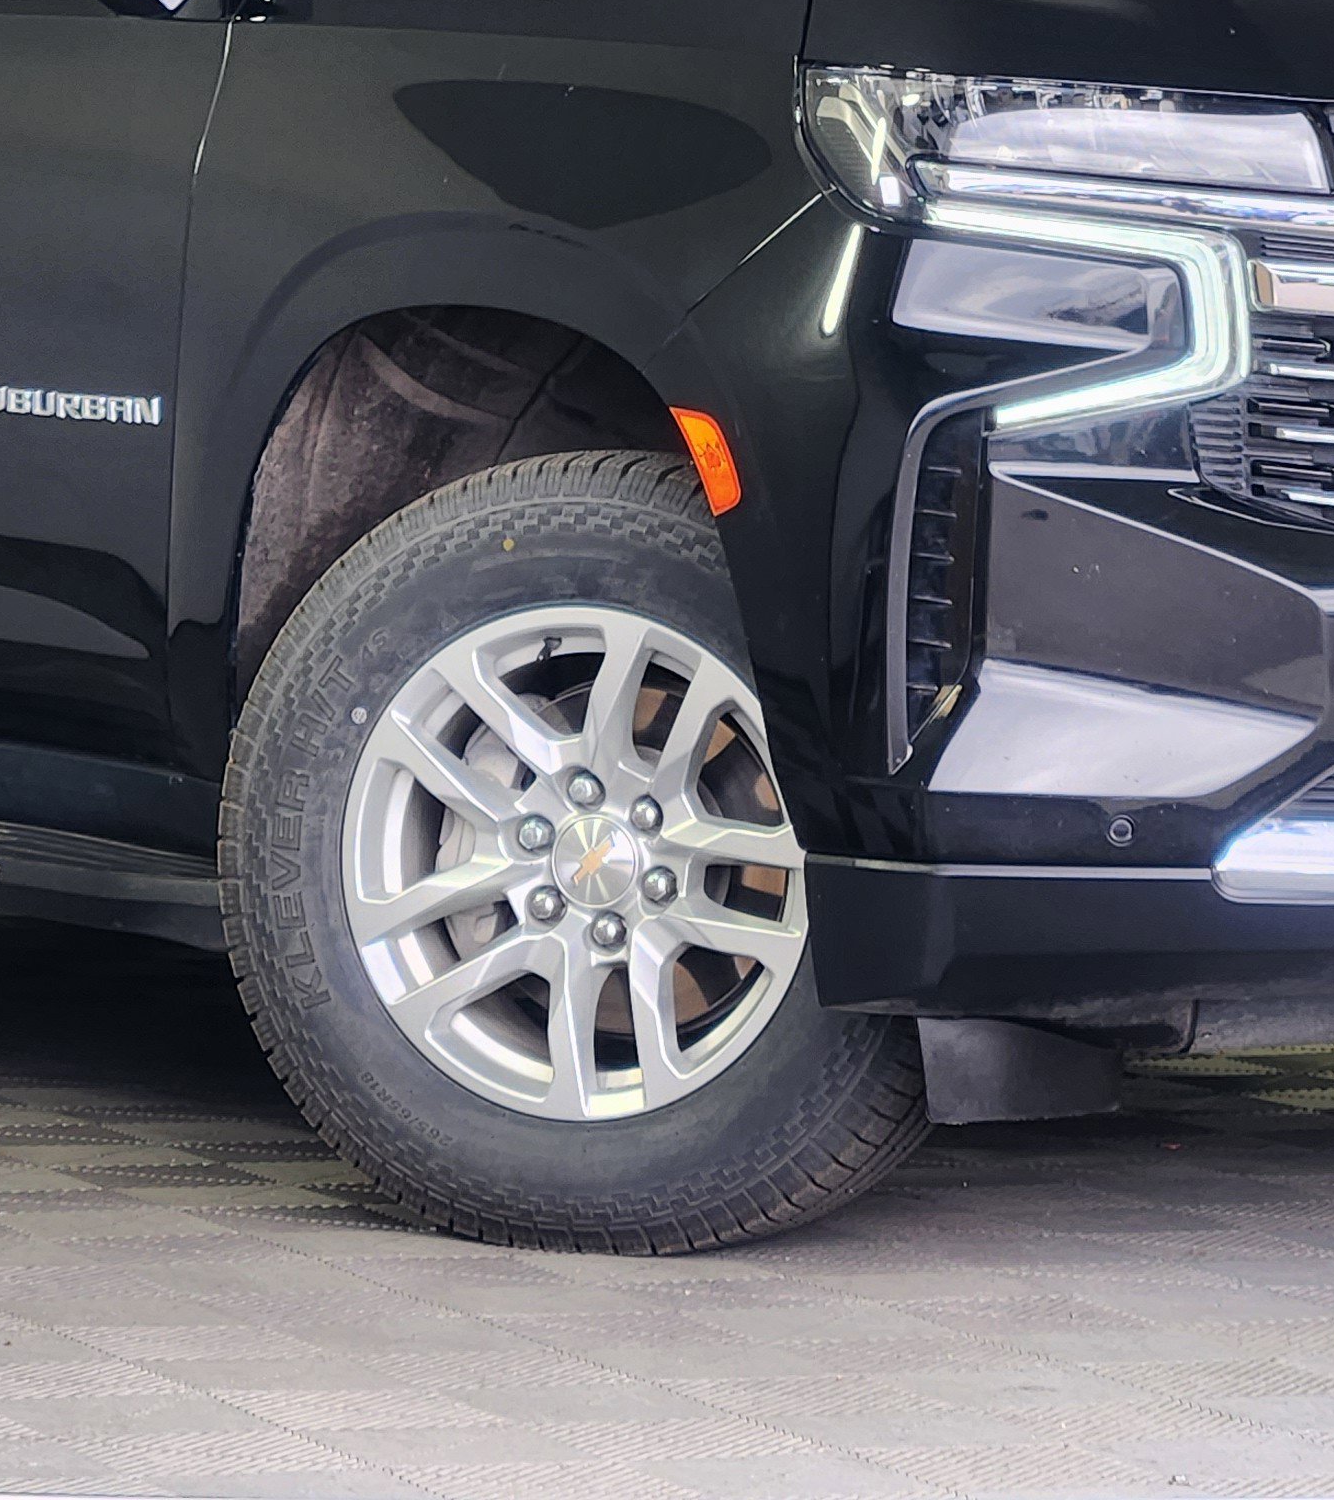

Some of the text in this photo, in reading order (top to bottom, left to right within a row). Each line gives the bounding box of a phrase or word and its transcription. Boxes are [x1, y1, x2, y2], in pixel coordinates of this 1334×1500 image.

[291, 654, 355, 757] H/T
[270, 767, 332, 1010] KLEVER
[360, 1071, 454, 1147] 265/65R18
